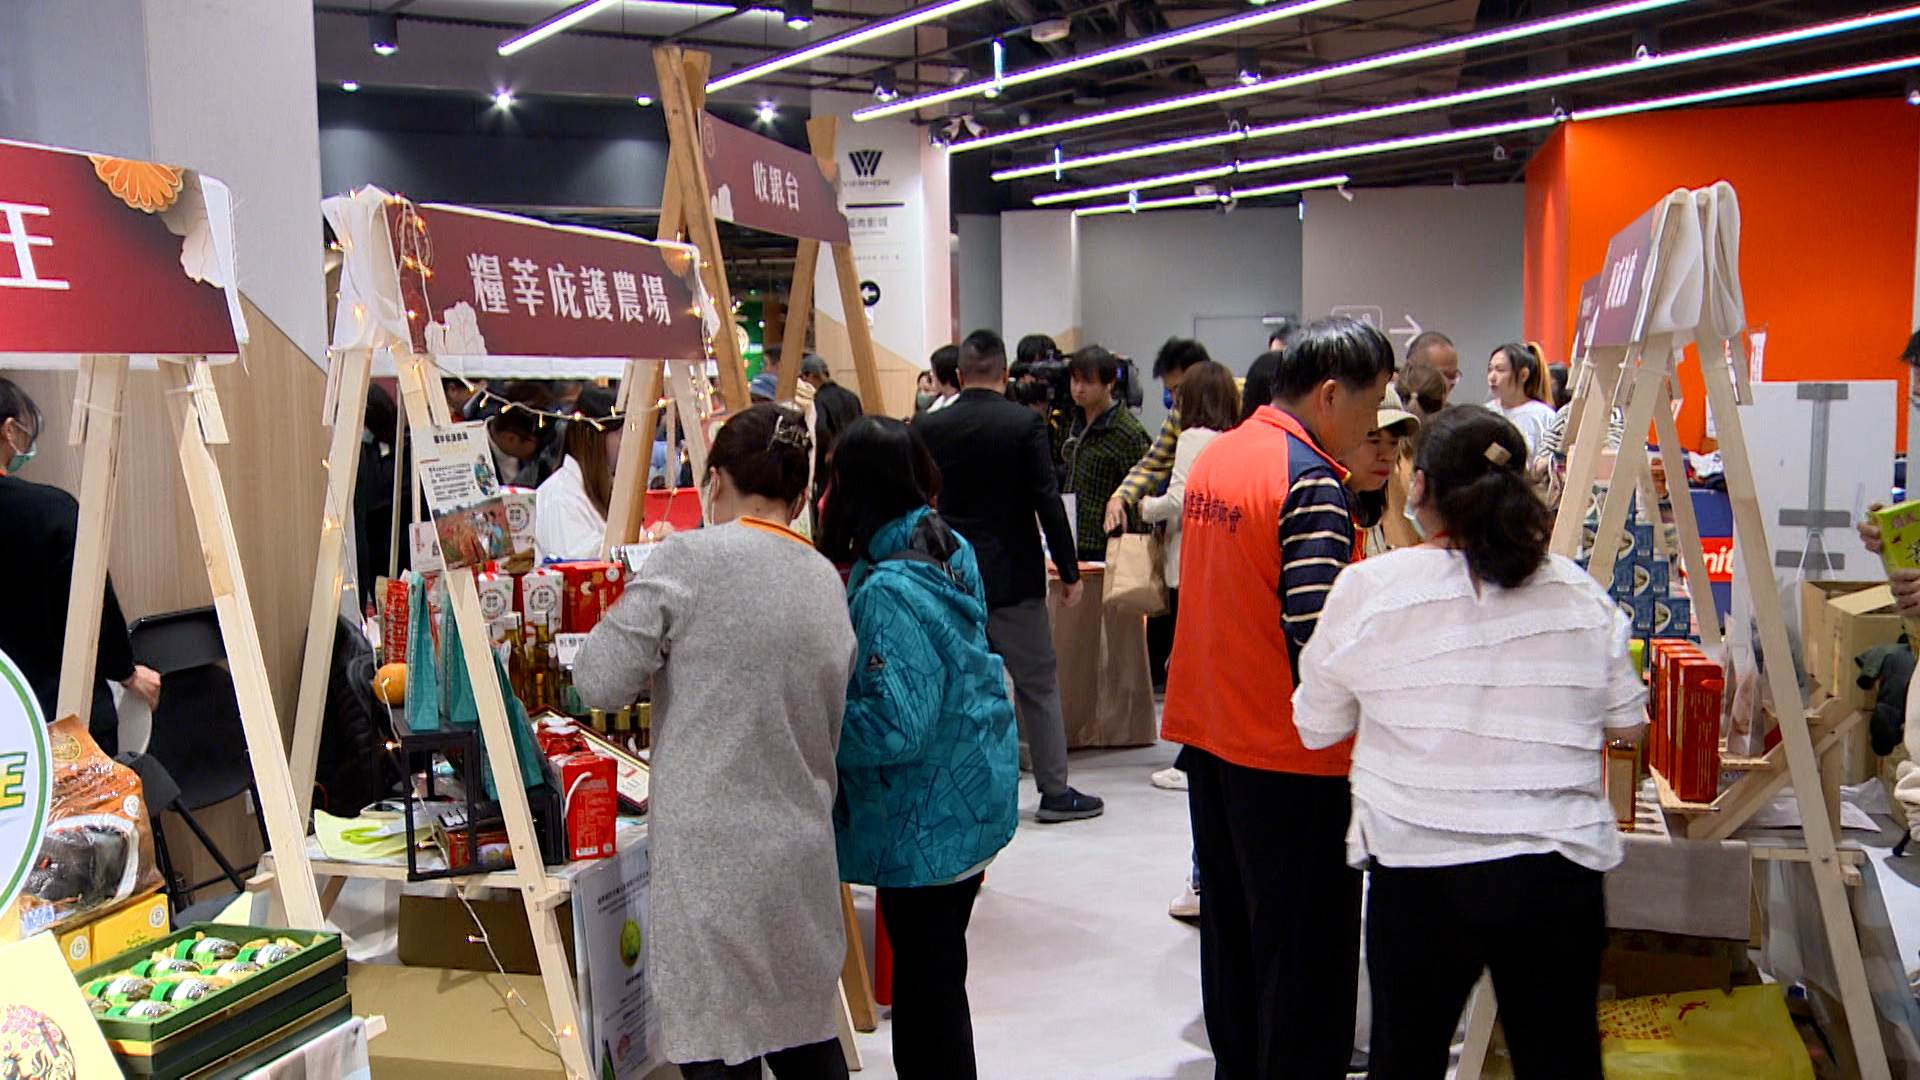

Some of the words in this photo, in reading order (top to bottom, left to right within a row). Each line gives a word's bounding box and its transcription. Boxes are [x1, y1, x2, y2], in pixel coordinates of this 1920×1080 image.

[752, 159, 800, 212] 收銀台
[466, 252, 672, 327] 糧莘庇護農場
